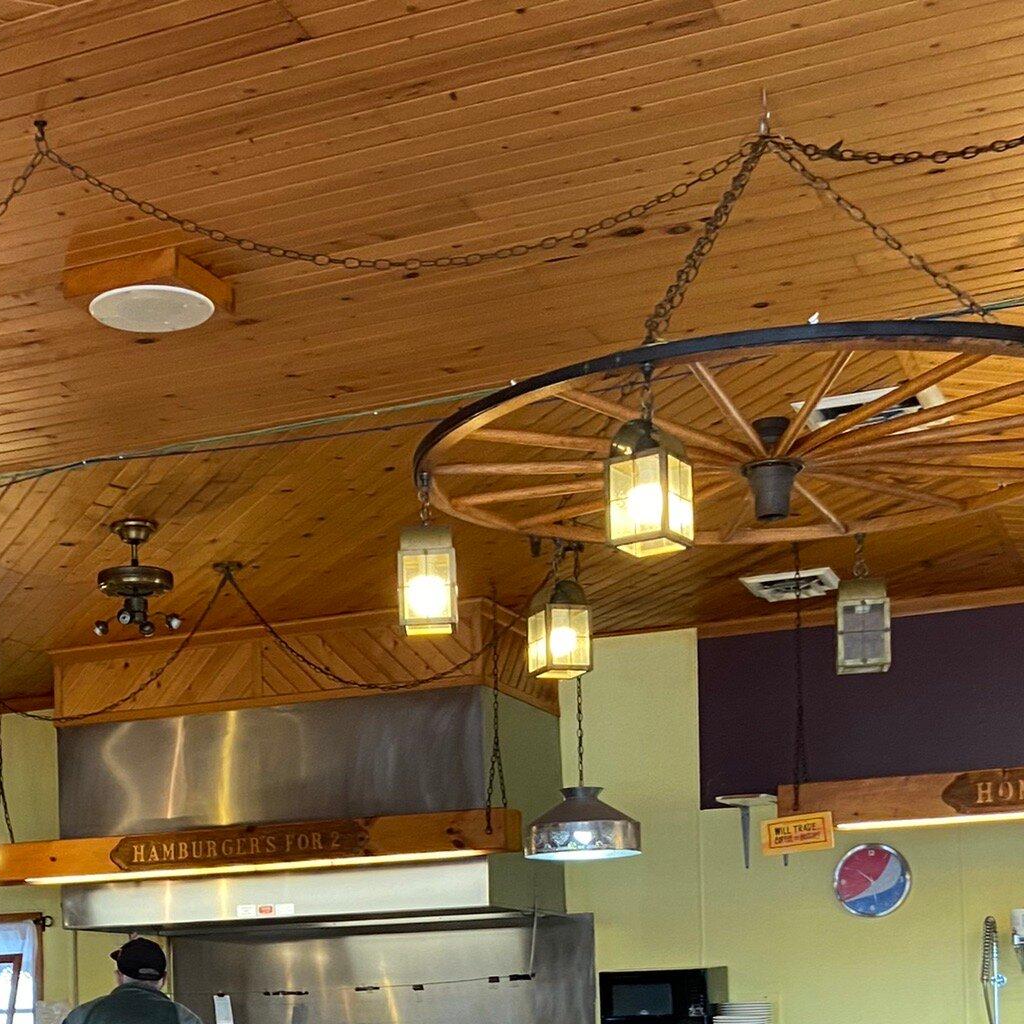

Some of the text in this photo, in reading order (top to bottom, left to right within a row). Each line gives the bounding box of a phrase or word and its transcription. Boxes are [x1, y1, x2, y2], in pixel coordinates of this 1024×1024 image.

[976, 780, 1024, 803] HO
[774, 822, 817, 835] WILL TRADE
[133, 830, 341, 863] HAMBURGER'S FOR 2
